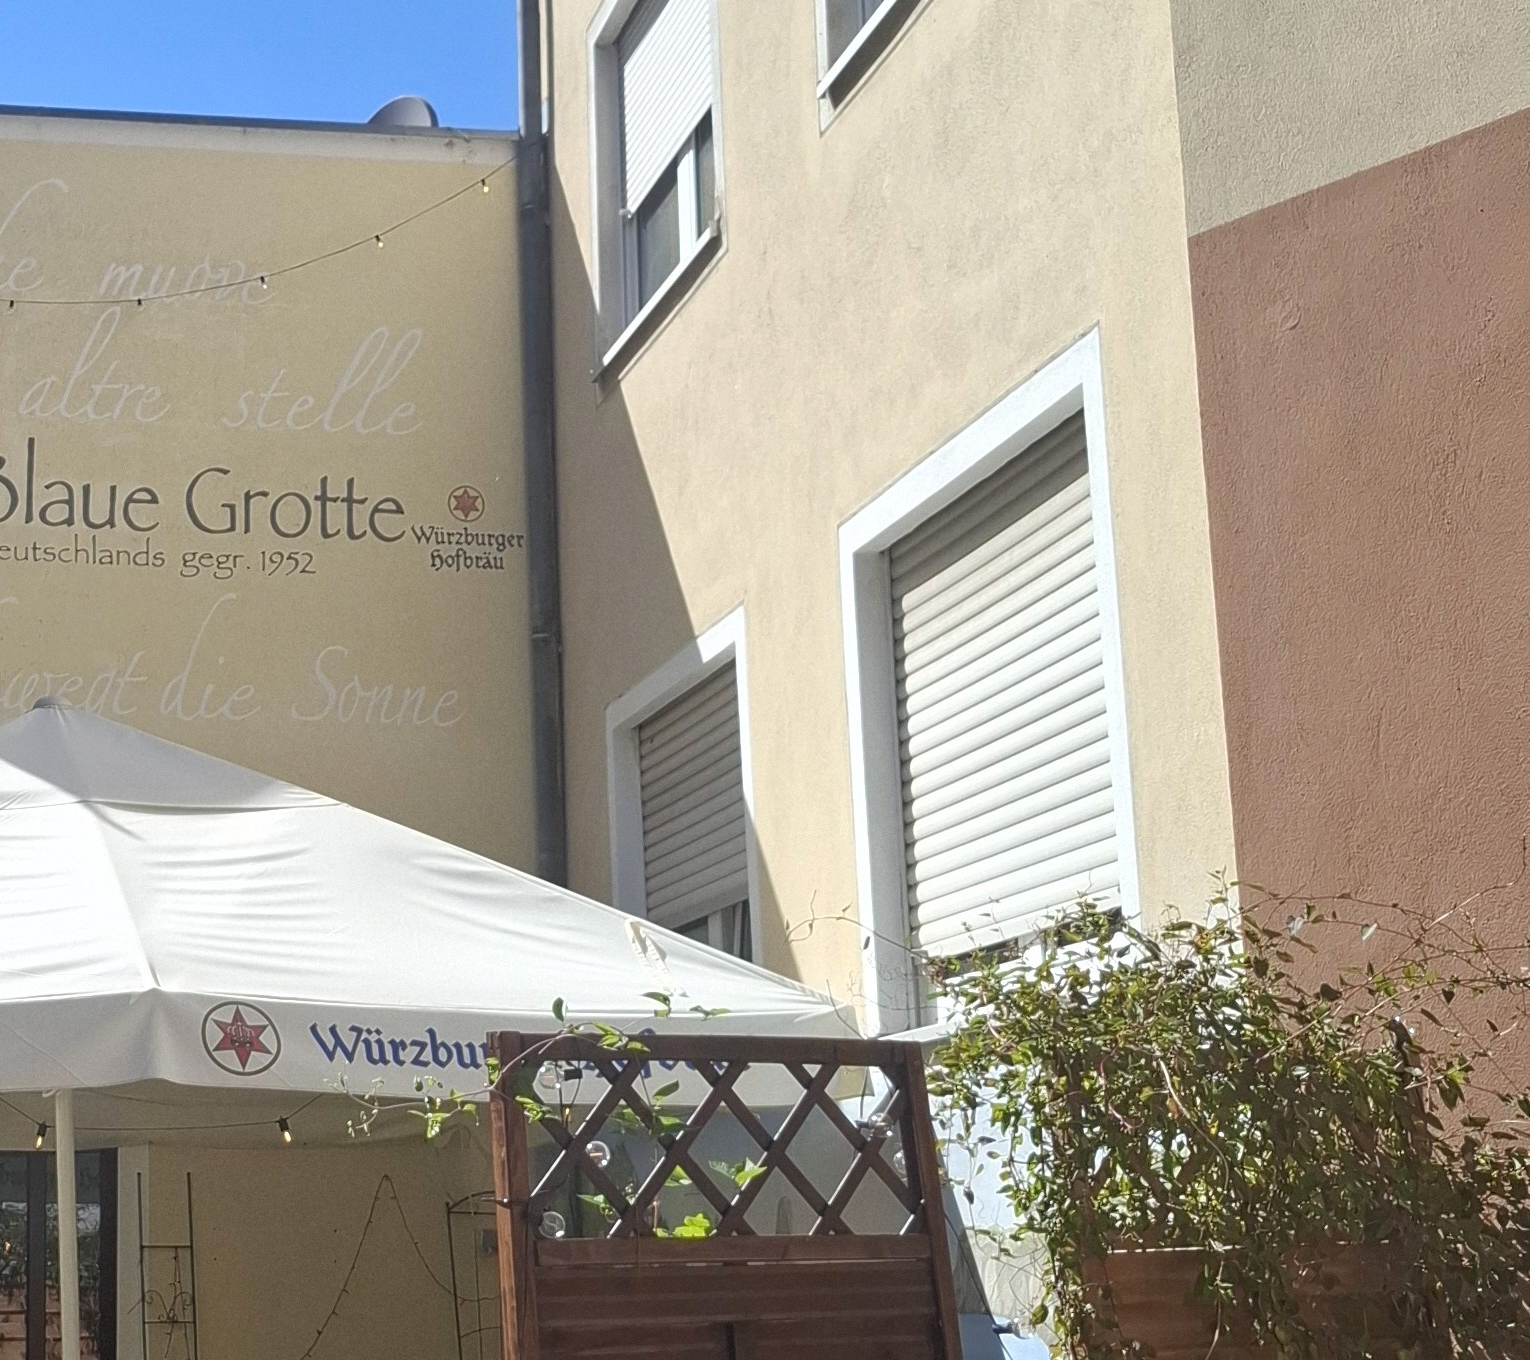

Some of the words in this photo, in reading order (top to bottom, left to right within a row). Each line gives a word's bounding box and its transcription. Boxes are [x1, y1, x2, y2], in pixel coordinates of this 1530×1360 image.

[17, 308, 171, 422] altre
[220, 326, 423, 436] stelle
[184, 466, 406, 542] Grotte
[179, 548, 252, 580] gegr.
[259, 549, 317, 576] 1952
[410, 525, 525, 551] Würzburger
[430, 548, 505, 573] Hofbräu
[159, 592, 261, 723] die
[291, 645, 467, 728] Sonne
